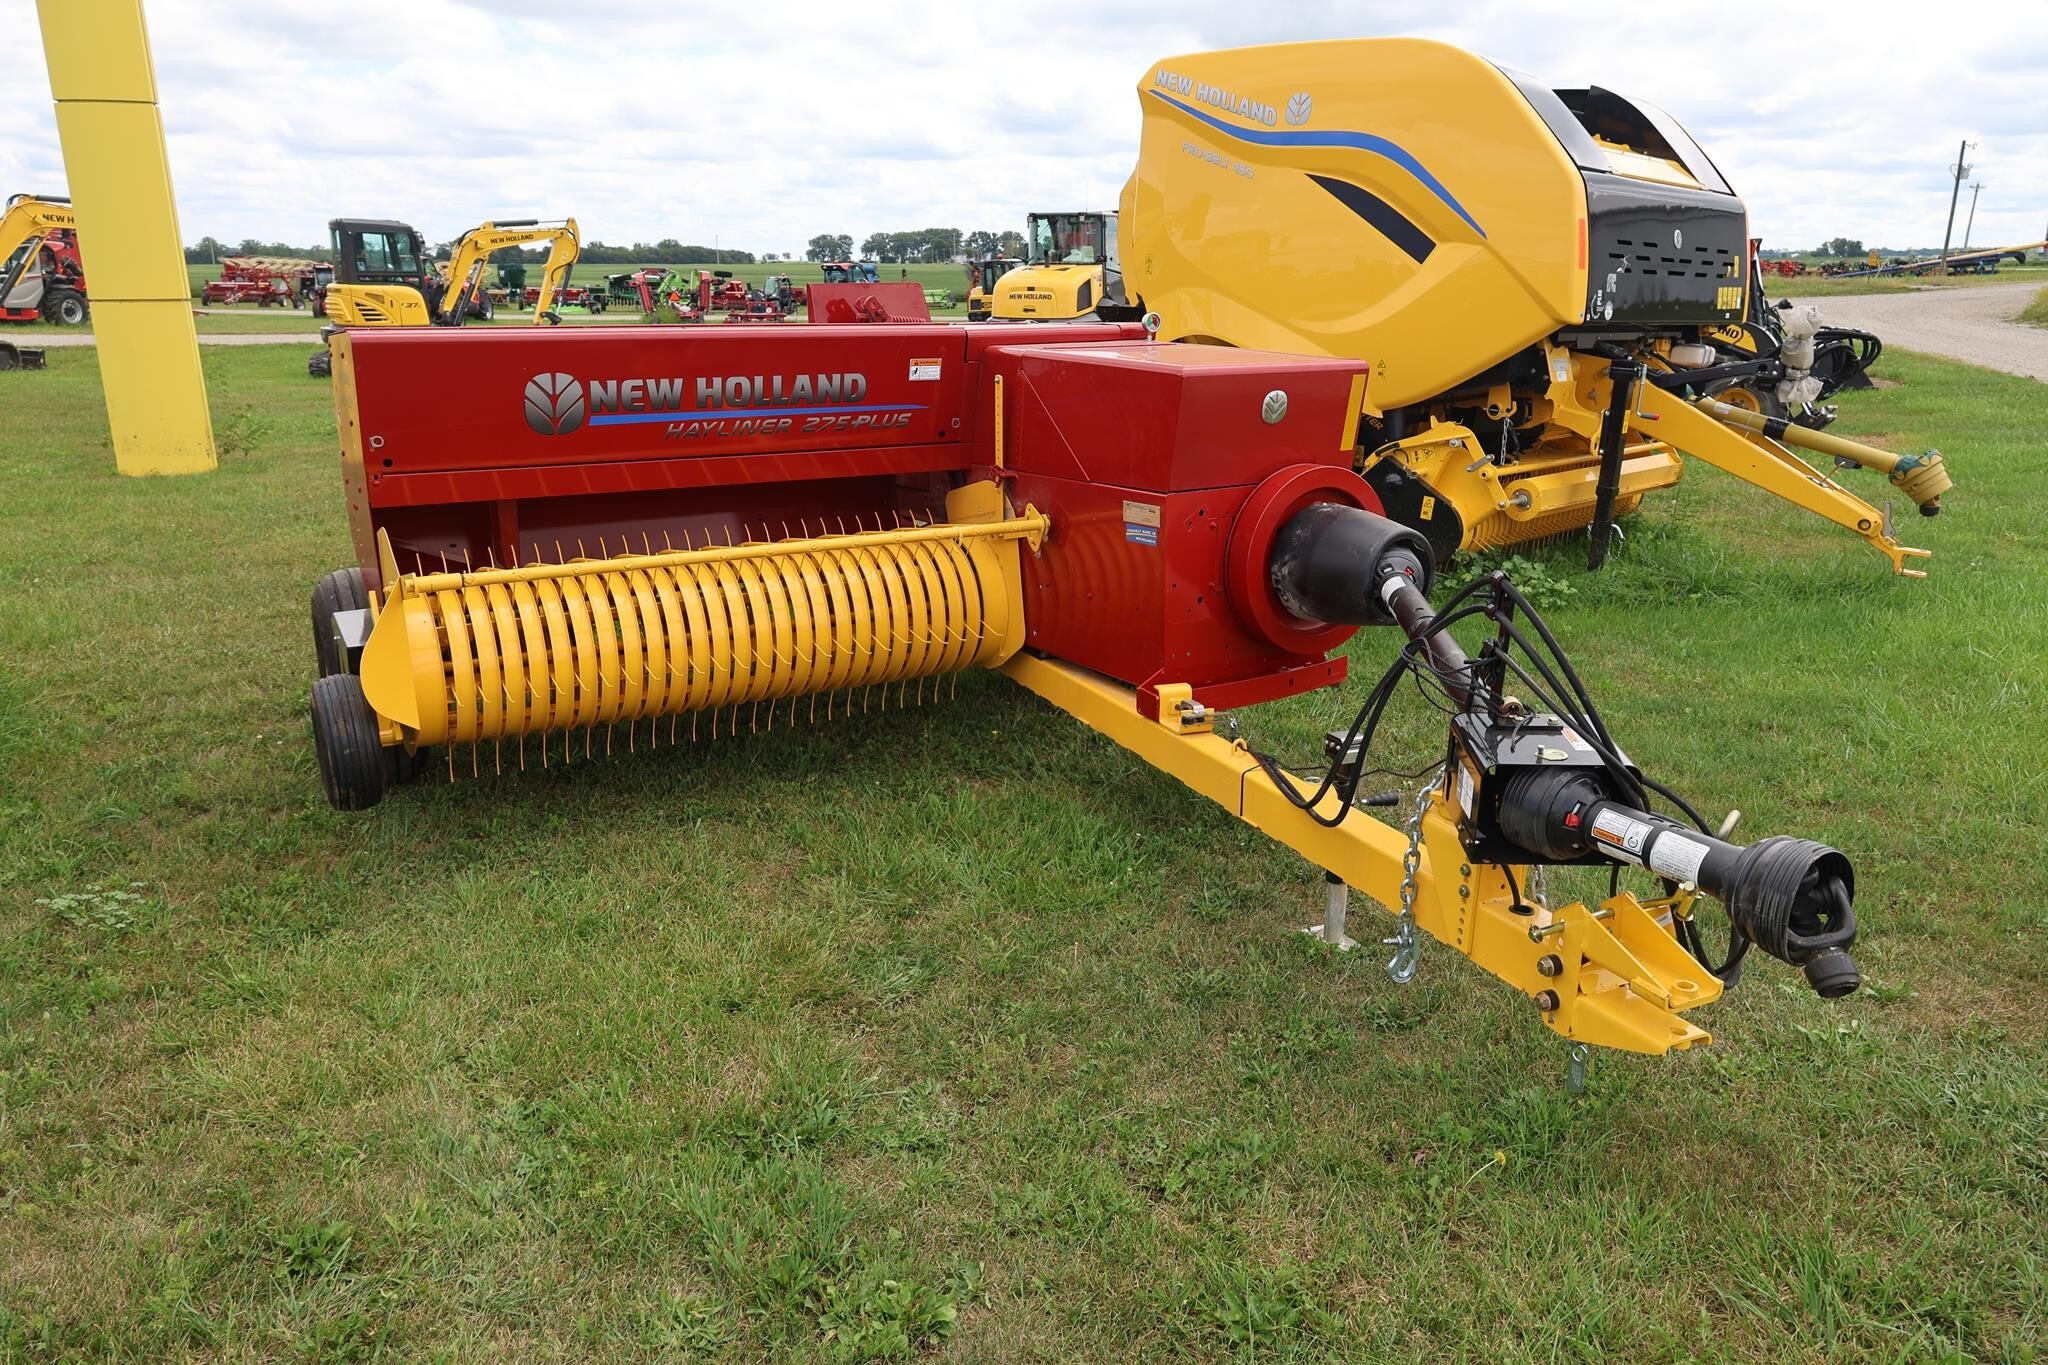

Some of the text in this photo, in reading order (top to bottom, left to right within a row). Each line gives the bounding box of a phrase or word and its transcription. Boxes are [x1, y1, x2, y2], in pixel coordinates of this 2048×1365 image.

[1154, 69, 1278, 127] NEW HOLLAND
[1182, 142, 1231, 170] PRO-BELT
[42, 213, 65, 222] NEW
[490, 233, 534, 245] NEW HOLLAND
[589, 372, 868, 412] NEW HOLLAND
[664, 417, 793, 441] HAYLINER
